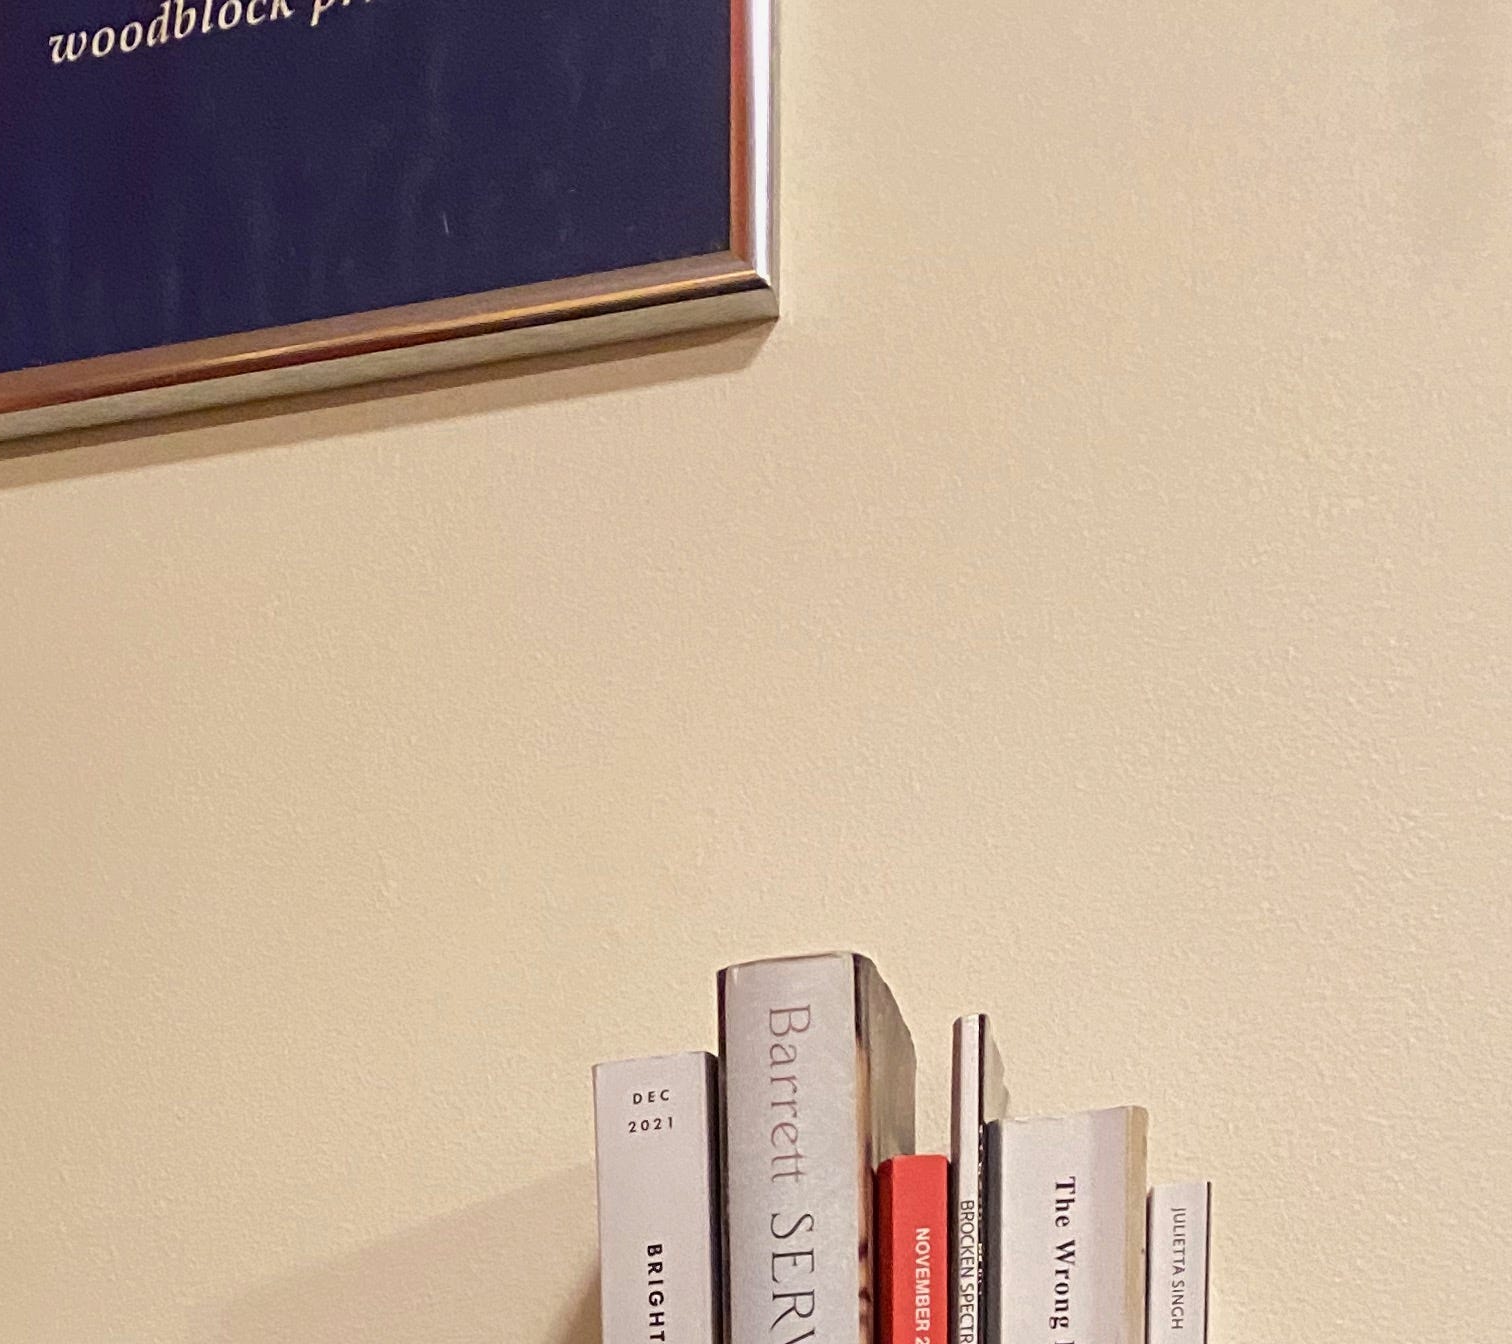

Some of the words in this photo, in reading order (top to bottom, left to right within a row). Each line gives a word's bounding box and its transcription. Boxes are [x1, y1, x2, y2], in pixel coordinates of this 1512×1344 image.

[628, 1116, 672, 1133] 2021
[632, 1088, 670, 1105] DEC
[766, 1004, 812, 1184] Barrett
[1054, 1176, 1076, 1228] The
[958, 1200, 975, 1278] BROCKEN
[1170, 1207, 1187, 1276] JULIETTA
[646, 1244, 666, 1343] BRIGHT
[914, 1227, 931, 1332] NOVEMBER
[1048, 1239, 1076, 1330] Wrong
[1170, 1280, 1185, 1330] SINGH
